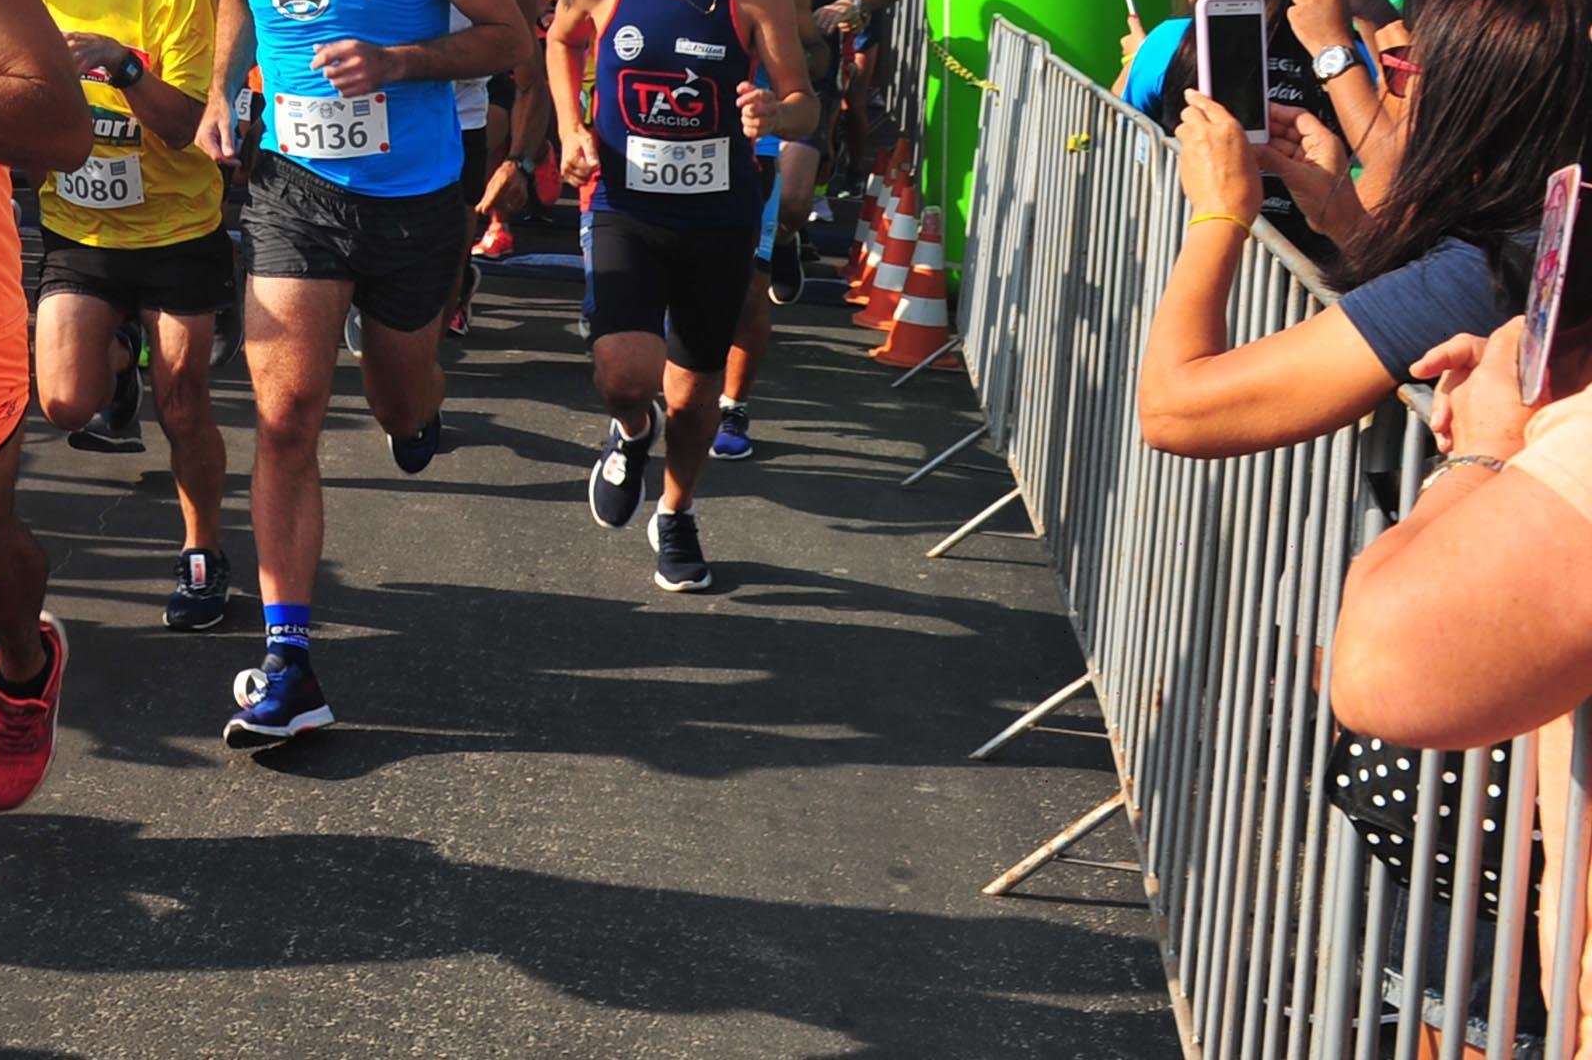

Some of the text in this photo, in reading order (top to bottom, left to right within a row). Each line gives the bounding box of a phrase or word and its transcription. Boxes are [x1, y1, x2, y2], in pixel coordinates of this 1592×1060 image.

[632, 82, 705, 117] TAG
[638, 113, 701, 127] TARCISO
[294, 121, 368, 150] 5136
[64, 172, 128, 202] 5080
[641, 162, 715, 187] 5063
